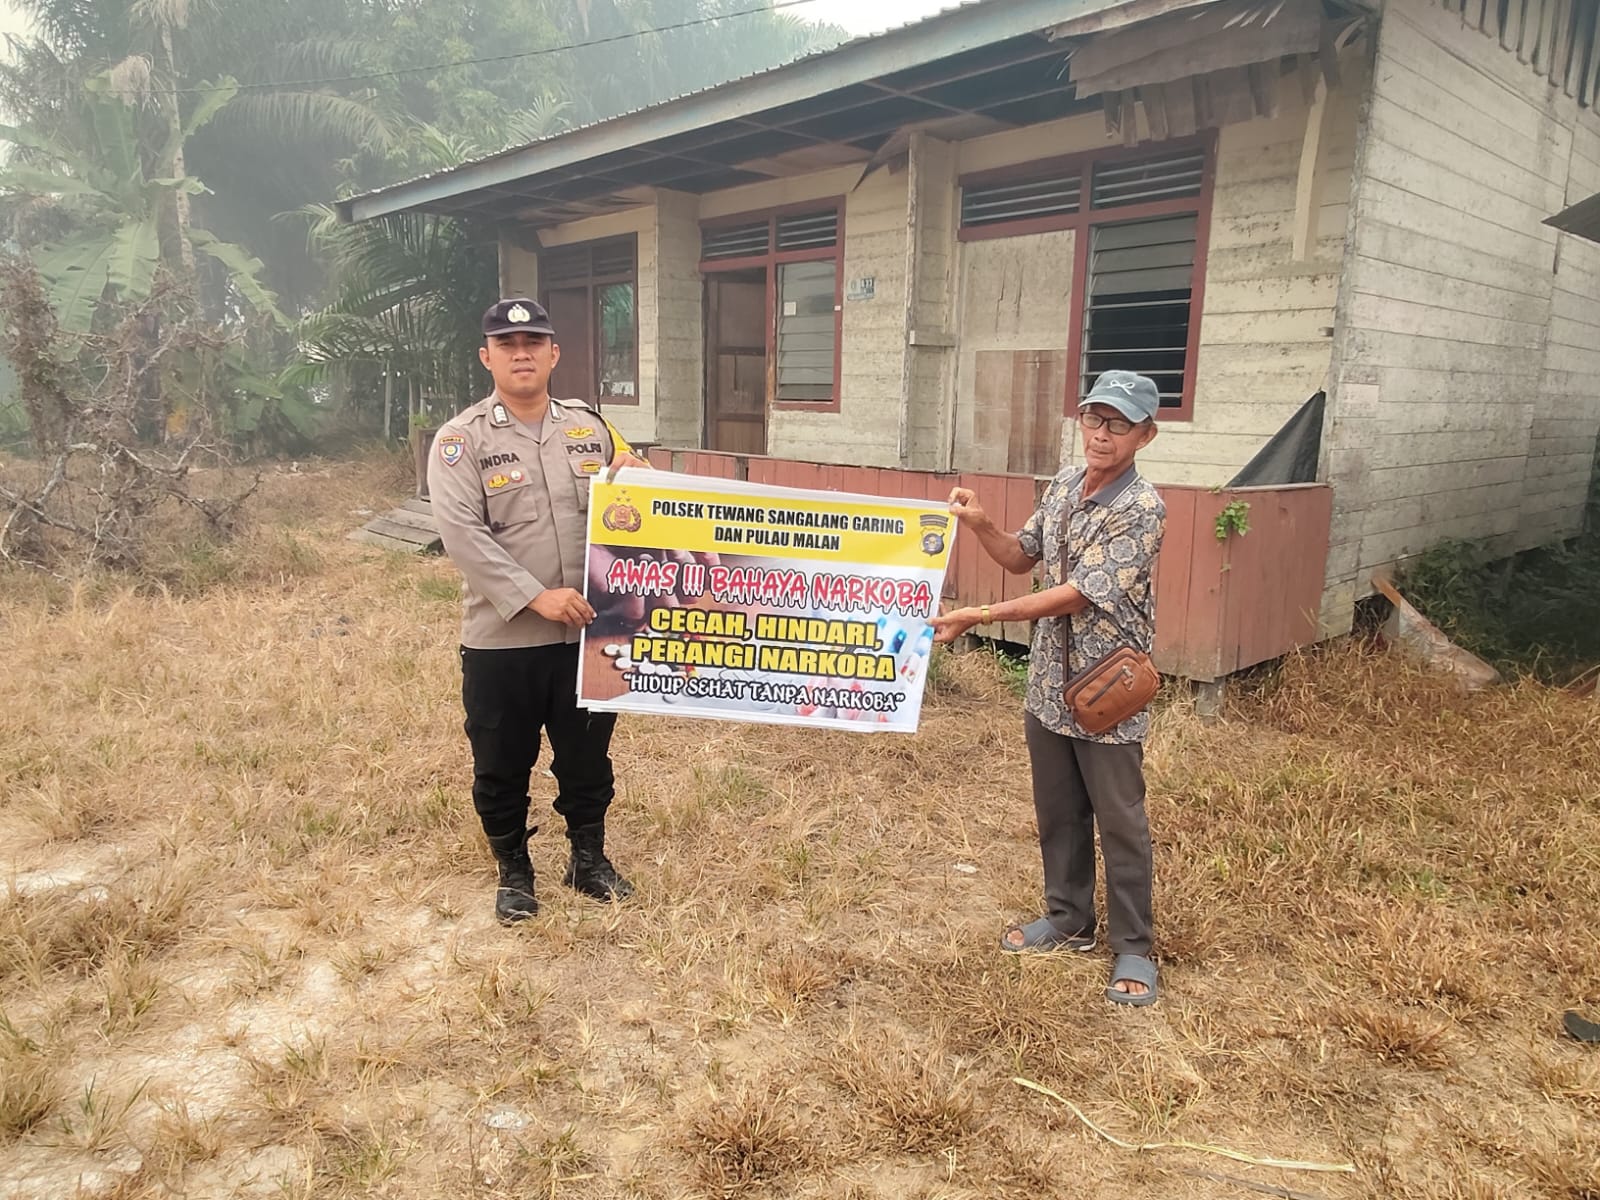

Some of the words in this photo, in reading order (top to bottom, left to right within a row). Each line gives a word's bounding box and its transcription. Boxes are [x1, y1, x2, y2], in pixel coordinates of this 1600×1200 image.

[480, 452, 520, 470] INDRA
[566, 443, 602, 455] POLRI
[652, 500, 704, 519] POLSEK
[708, 504, 764, 523] TEWANG
[768, 509, 848, 530] SANGALANG
[852, 516, 904, 534] GARING
[714, 526, 742, 542] DAN
[746, 530, 789, 546] PULAU
[793, 533, 840, 550] MALAN
[607, 557, 679, 597] AWAS
[709, 565, 808, 609] BAHAYA
[811, 573, 933, 617] NARKOBA
[650, 608, 752, 640] CEGAH,
[756, 615, 883, 650] HINDARI,
[631, 637, 757, 669] PERANGI
[760, 646, 896, 681] NARKOBA
[624, 673, 685, 695] “HIDUP
[686, 676, 748, 699] SEHAT
[750, 682, 810, 705] TANPA
[813, 686, 906, 711] NARKOBA”
